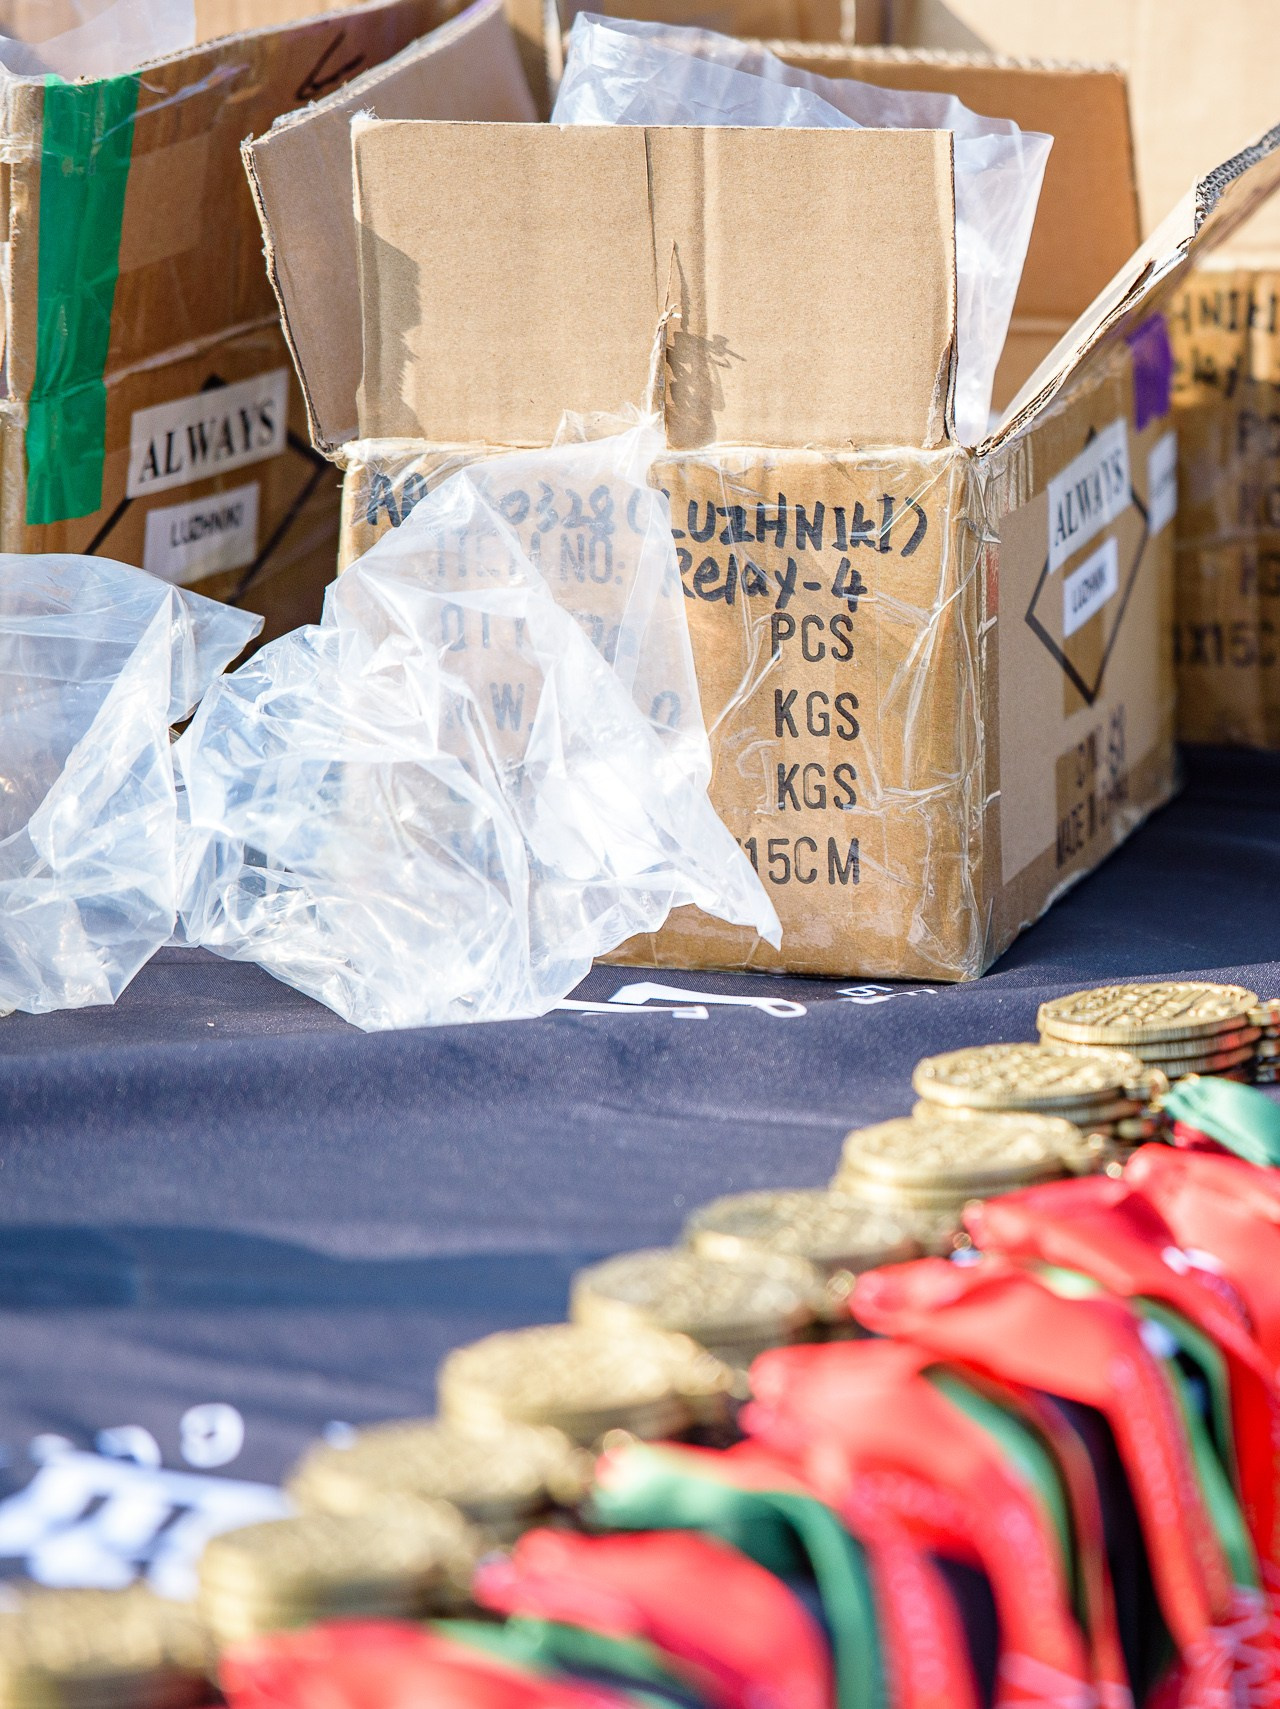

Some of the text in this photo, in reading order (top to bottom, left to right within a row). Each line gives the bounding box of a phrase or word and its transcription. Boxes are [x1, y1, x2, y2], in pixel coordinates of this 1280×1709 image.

[138, 399, 276, 483] ALWAYS
[1055, 448, 1124, 547] ALWAYS
[560, 532, 627, 584] NO:
[770, 612, 854, 662] PCS
[774, 688, 861, 742] KGS
[777, 762, 858, 812] KGS
[738, 836, 861, 885] 15CM
